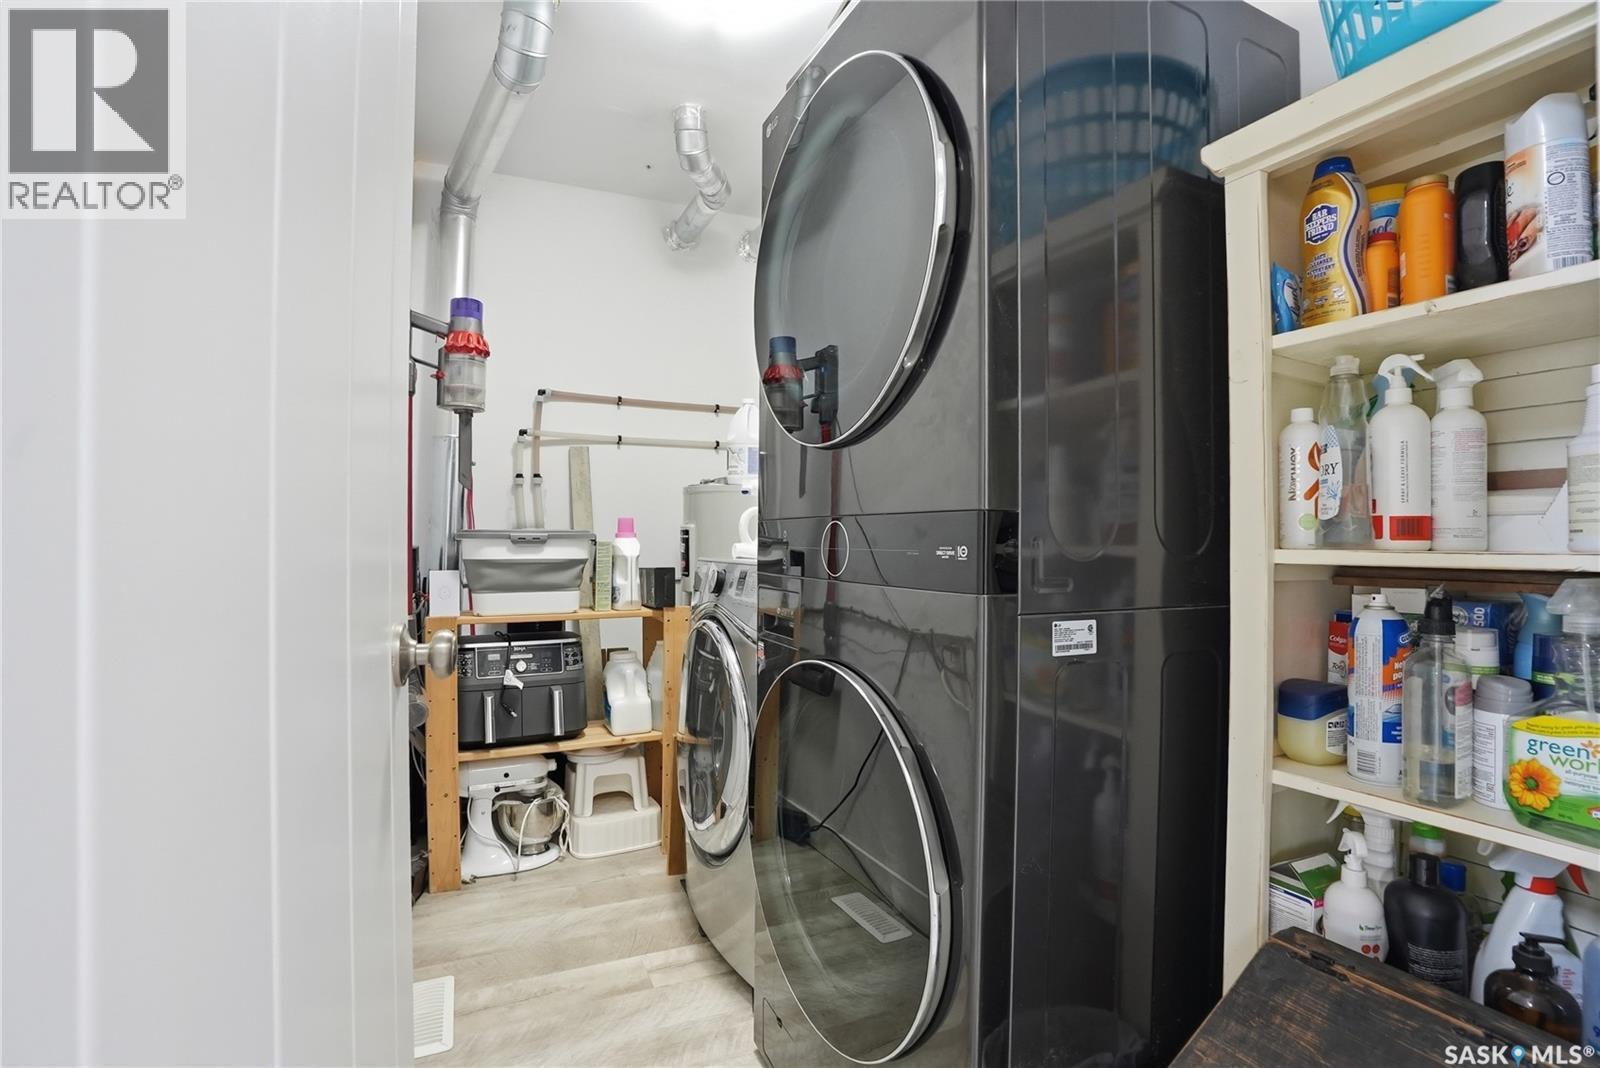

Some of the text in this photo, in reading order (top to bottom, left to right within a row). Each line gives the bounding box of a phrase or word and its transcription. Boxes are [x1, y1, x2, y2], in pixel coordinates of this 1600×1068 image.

[1306, 213, 1337, 230] KEEPERS
[1312, 208, 1328, 221] BAR
[1307, 222, 1335, 239] FRIEND
[1526, 738, 1590, 760] green
[1549, 754, 1600, 774] wor
